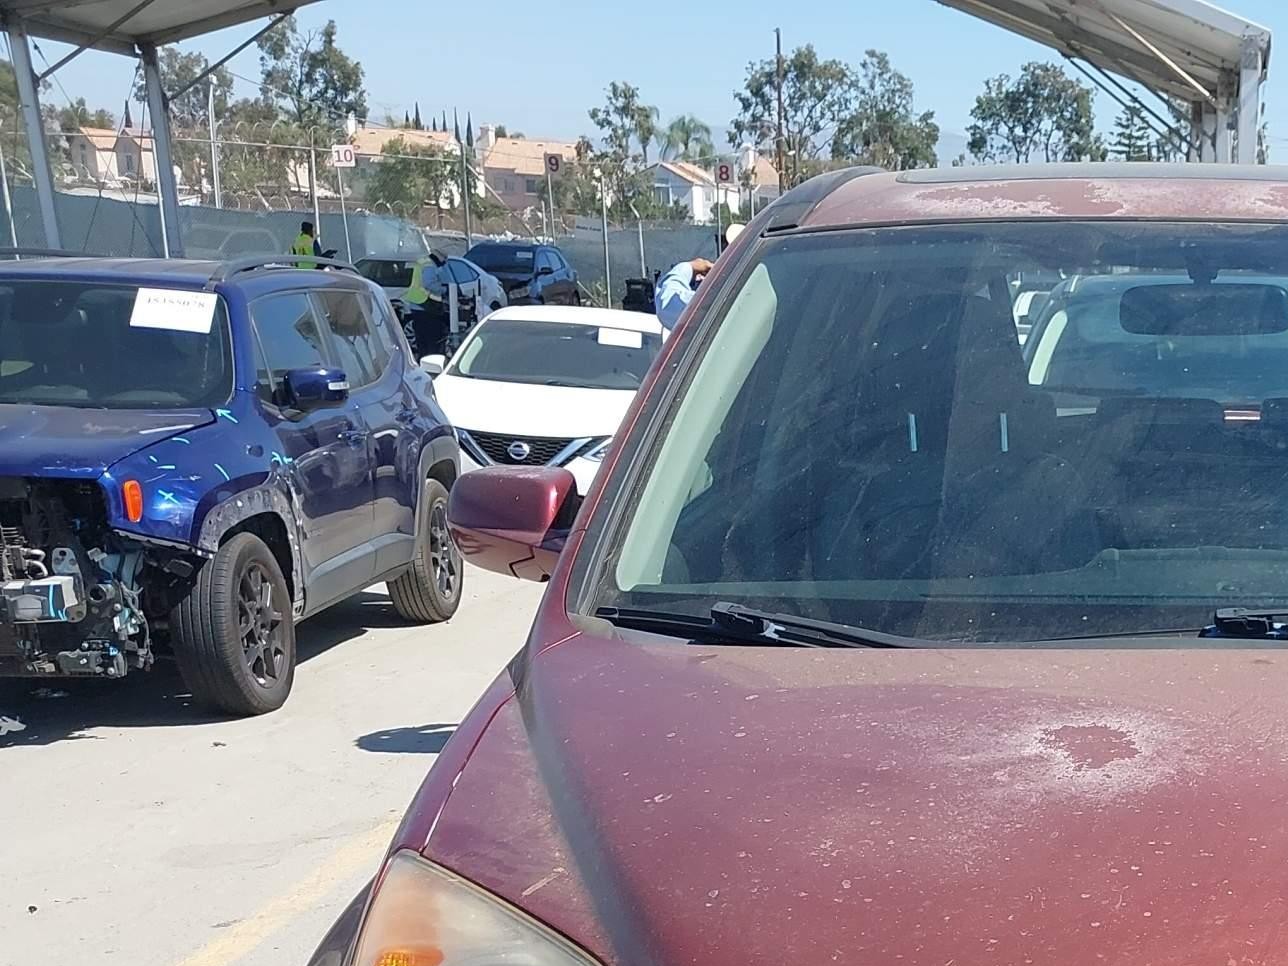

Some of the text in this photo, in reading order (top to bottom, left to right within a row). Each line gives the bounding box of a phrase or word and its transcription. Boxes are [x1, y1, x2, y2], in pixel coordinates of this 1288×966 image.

[334, 149, 353, 163] 10
[549, 156, 560, 172] 9
[719, 165, 730, 181] 8
